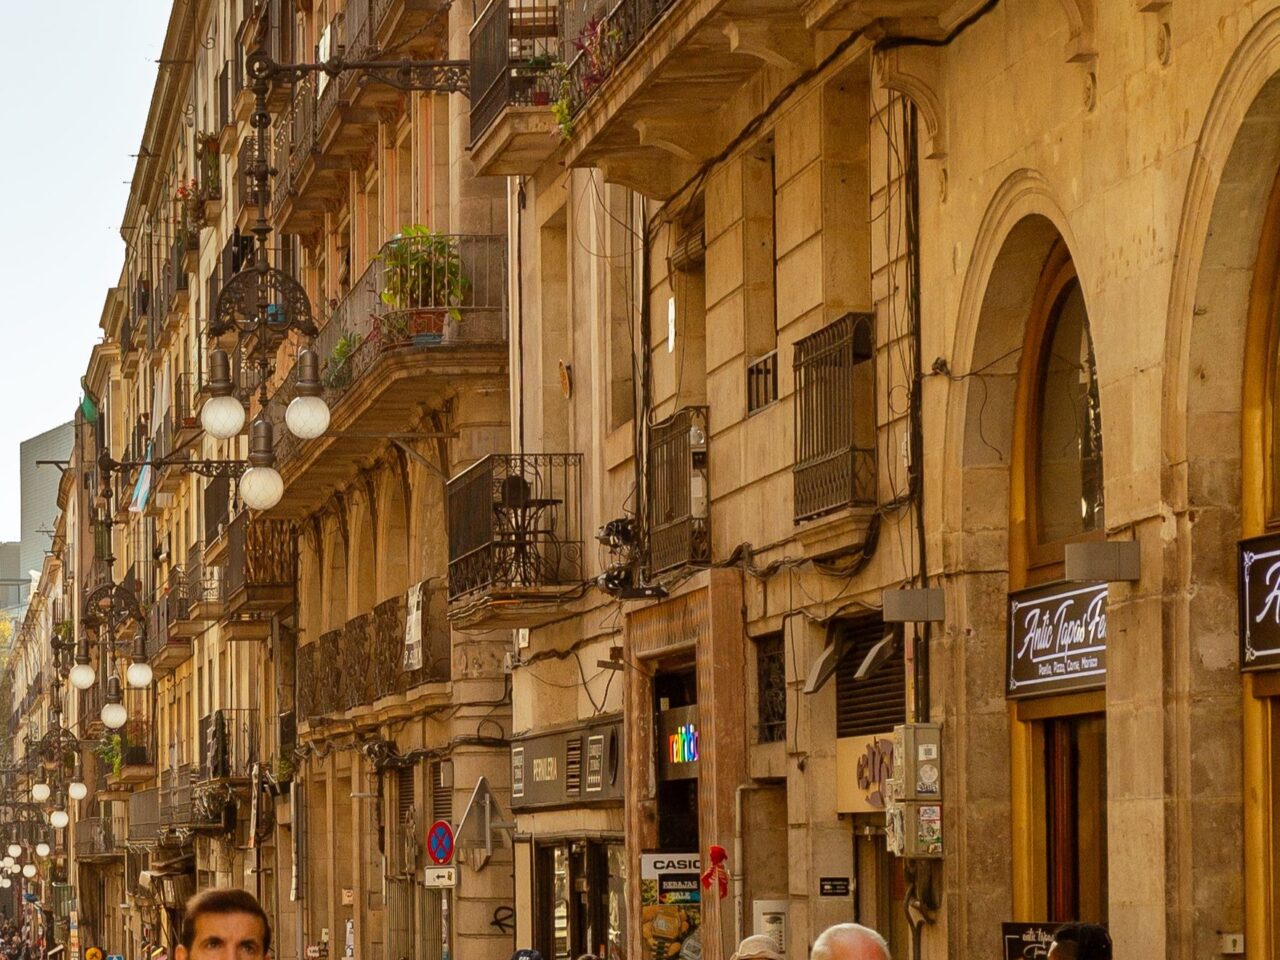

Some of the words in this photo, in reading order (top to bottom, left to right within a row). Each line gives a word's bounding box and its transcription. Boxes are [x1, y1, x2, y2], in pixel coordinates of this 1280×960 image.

[1018, 608, 1053, 660] Antic
[1053, 600, 1087, 664] Tapas
[669, 722, 699, 763] rainbo
